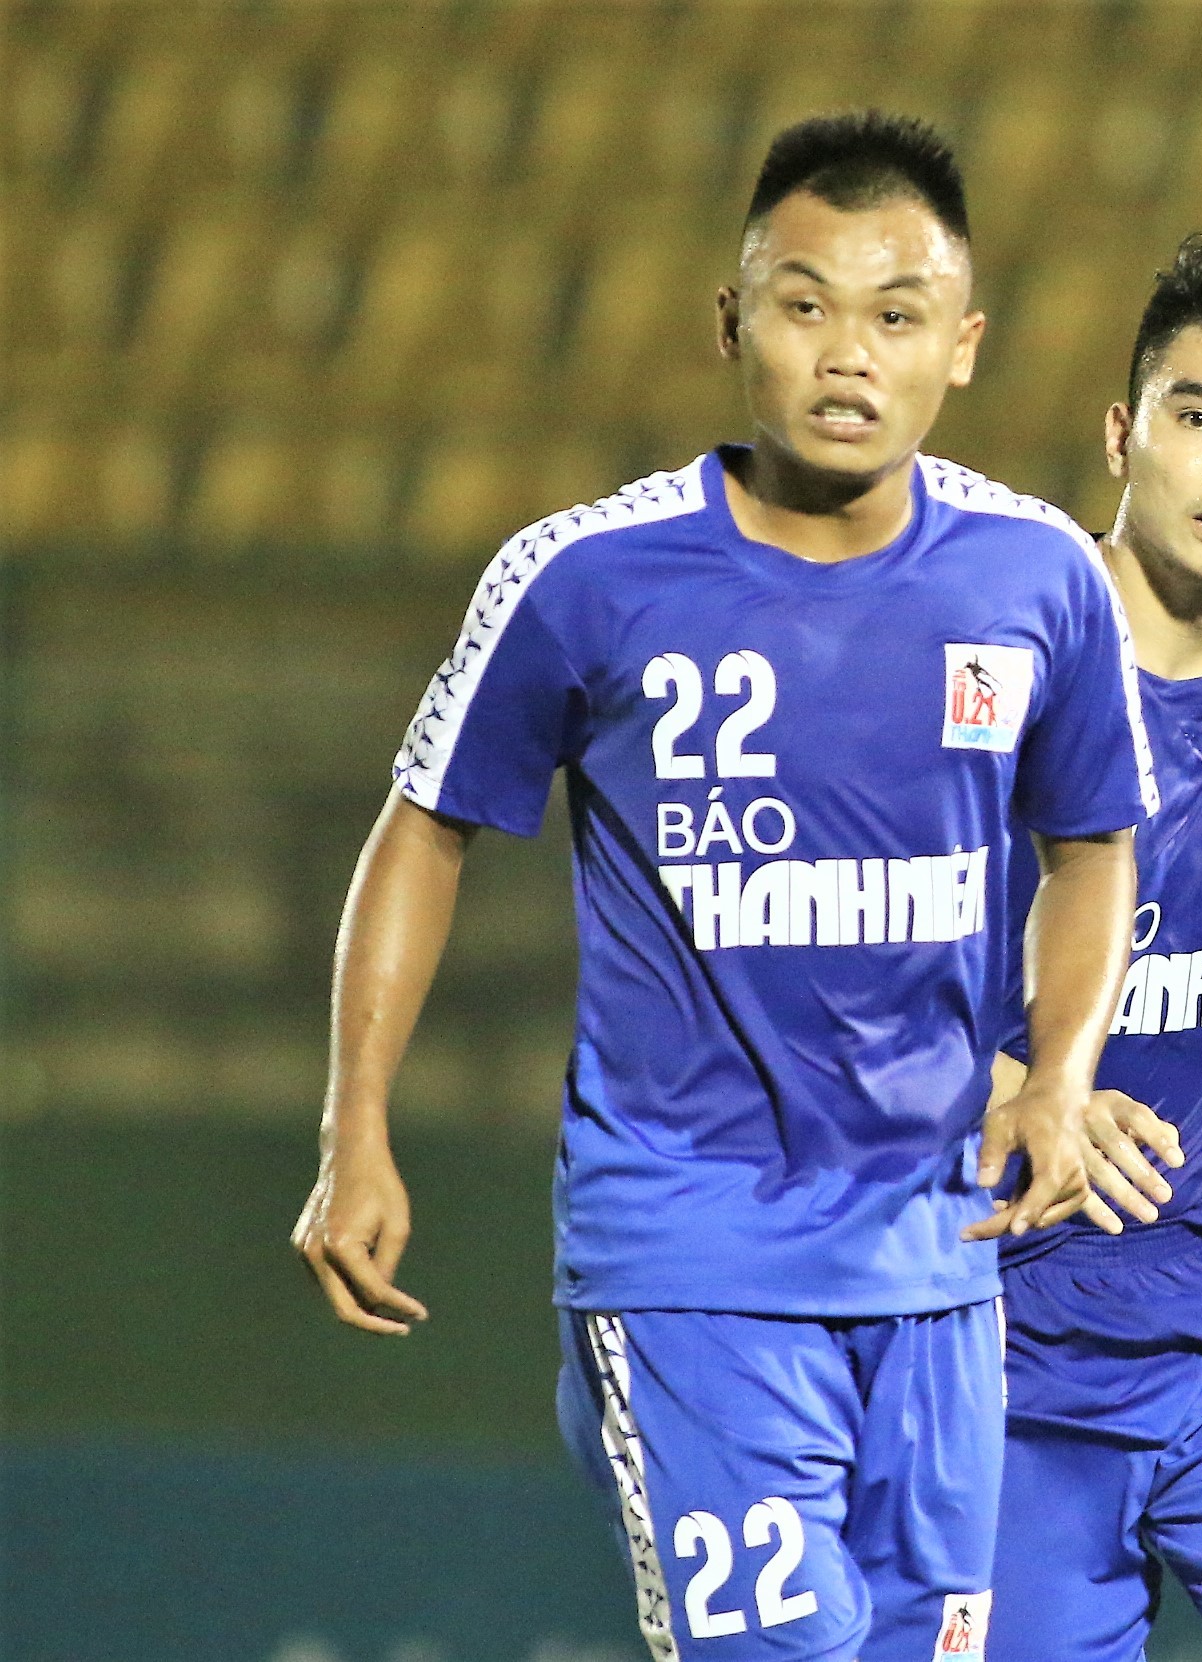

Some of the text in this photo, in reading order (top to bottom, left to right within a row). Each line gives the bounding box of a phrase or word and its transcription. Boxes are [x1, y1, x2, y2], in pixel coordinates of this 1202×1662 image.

[642, 649, 778, 779] 22
[657, 787, 796, 857] BÁO
[674, 1496, 819, 1639] 22
